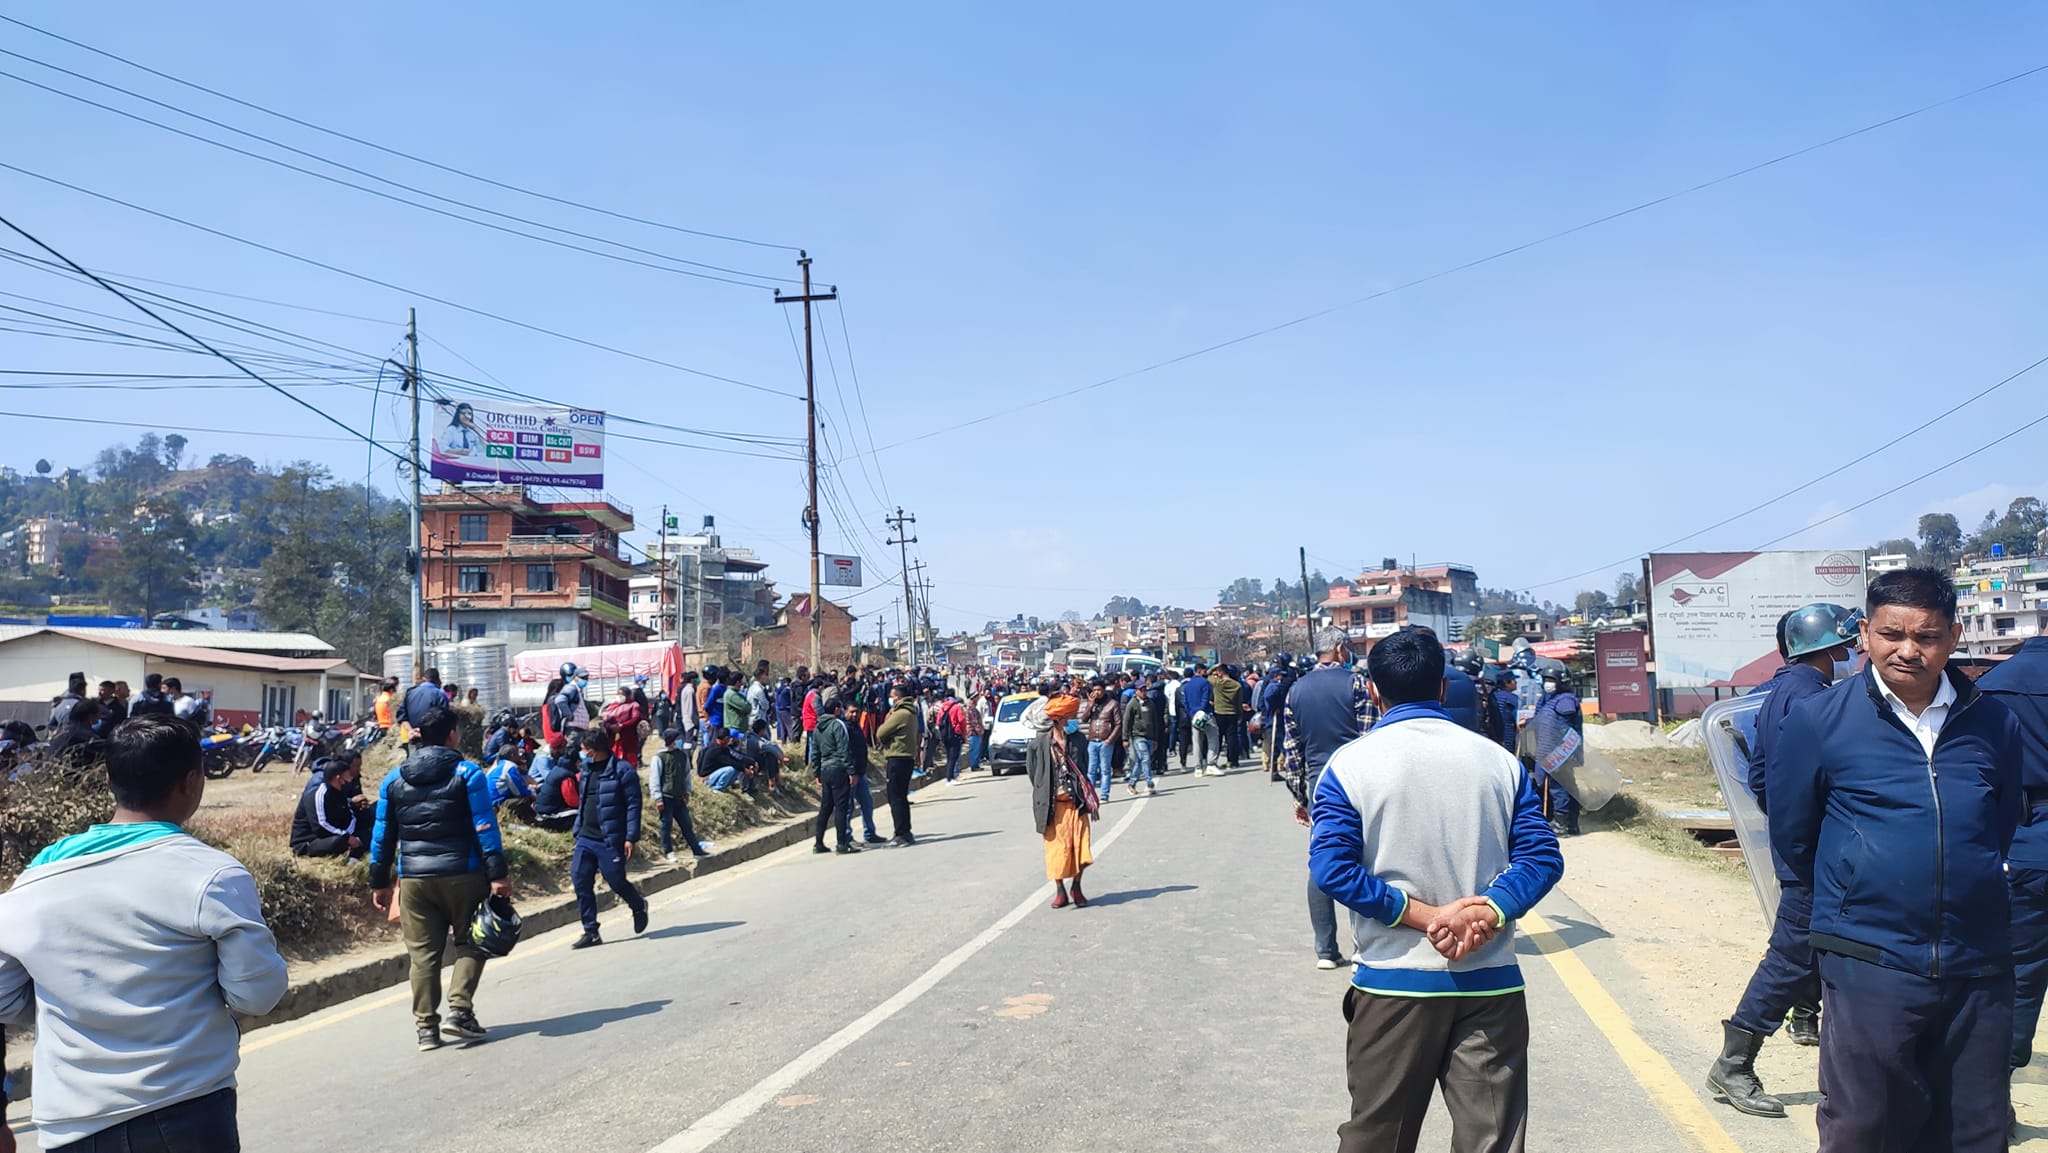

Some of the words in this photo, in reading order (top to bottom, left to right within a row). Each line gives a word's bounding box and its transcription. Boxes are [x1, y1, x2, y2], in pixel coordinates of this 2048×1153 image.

[487, 411, 537, 426] ORCHID
[570, 412, 603, 425] OPEN
[540, 423, 572, 435] College
[521, 433, 539, 444] BIM
[1699, 586, 1725, 594] AAC
